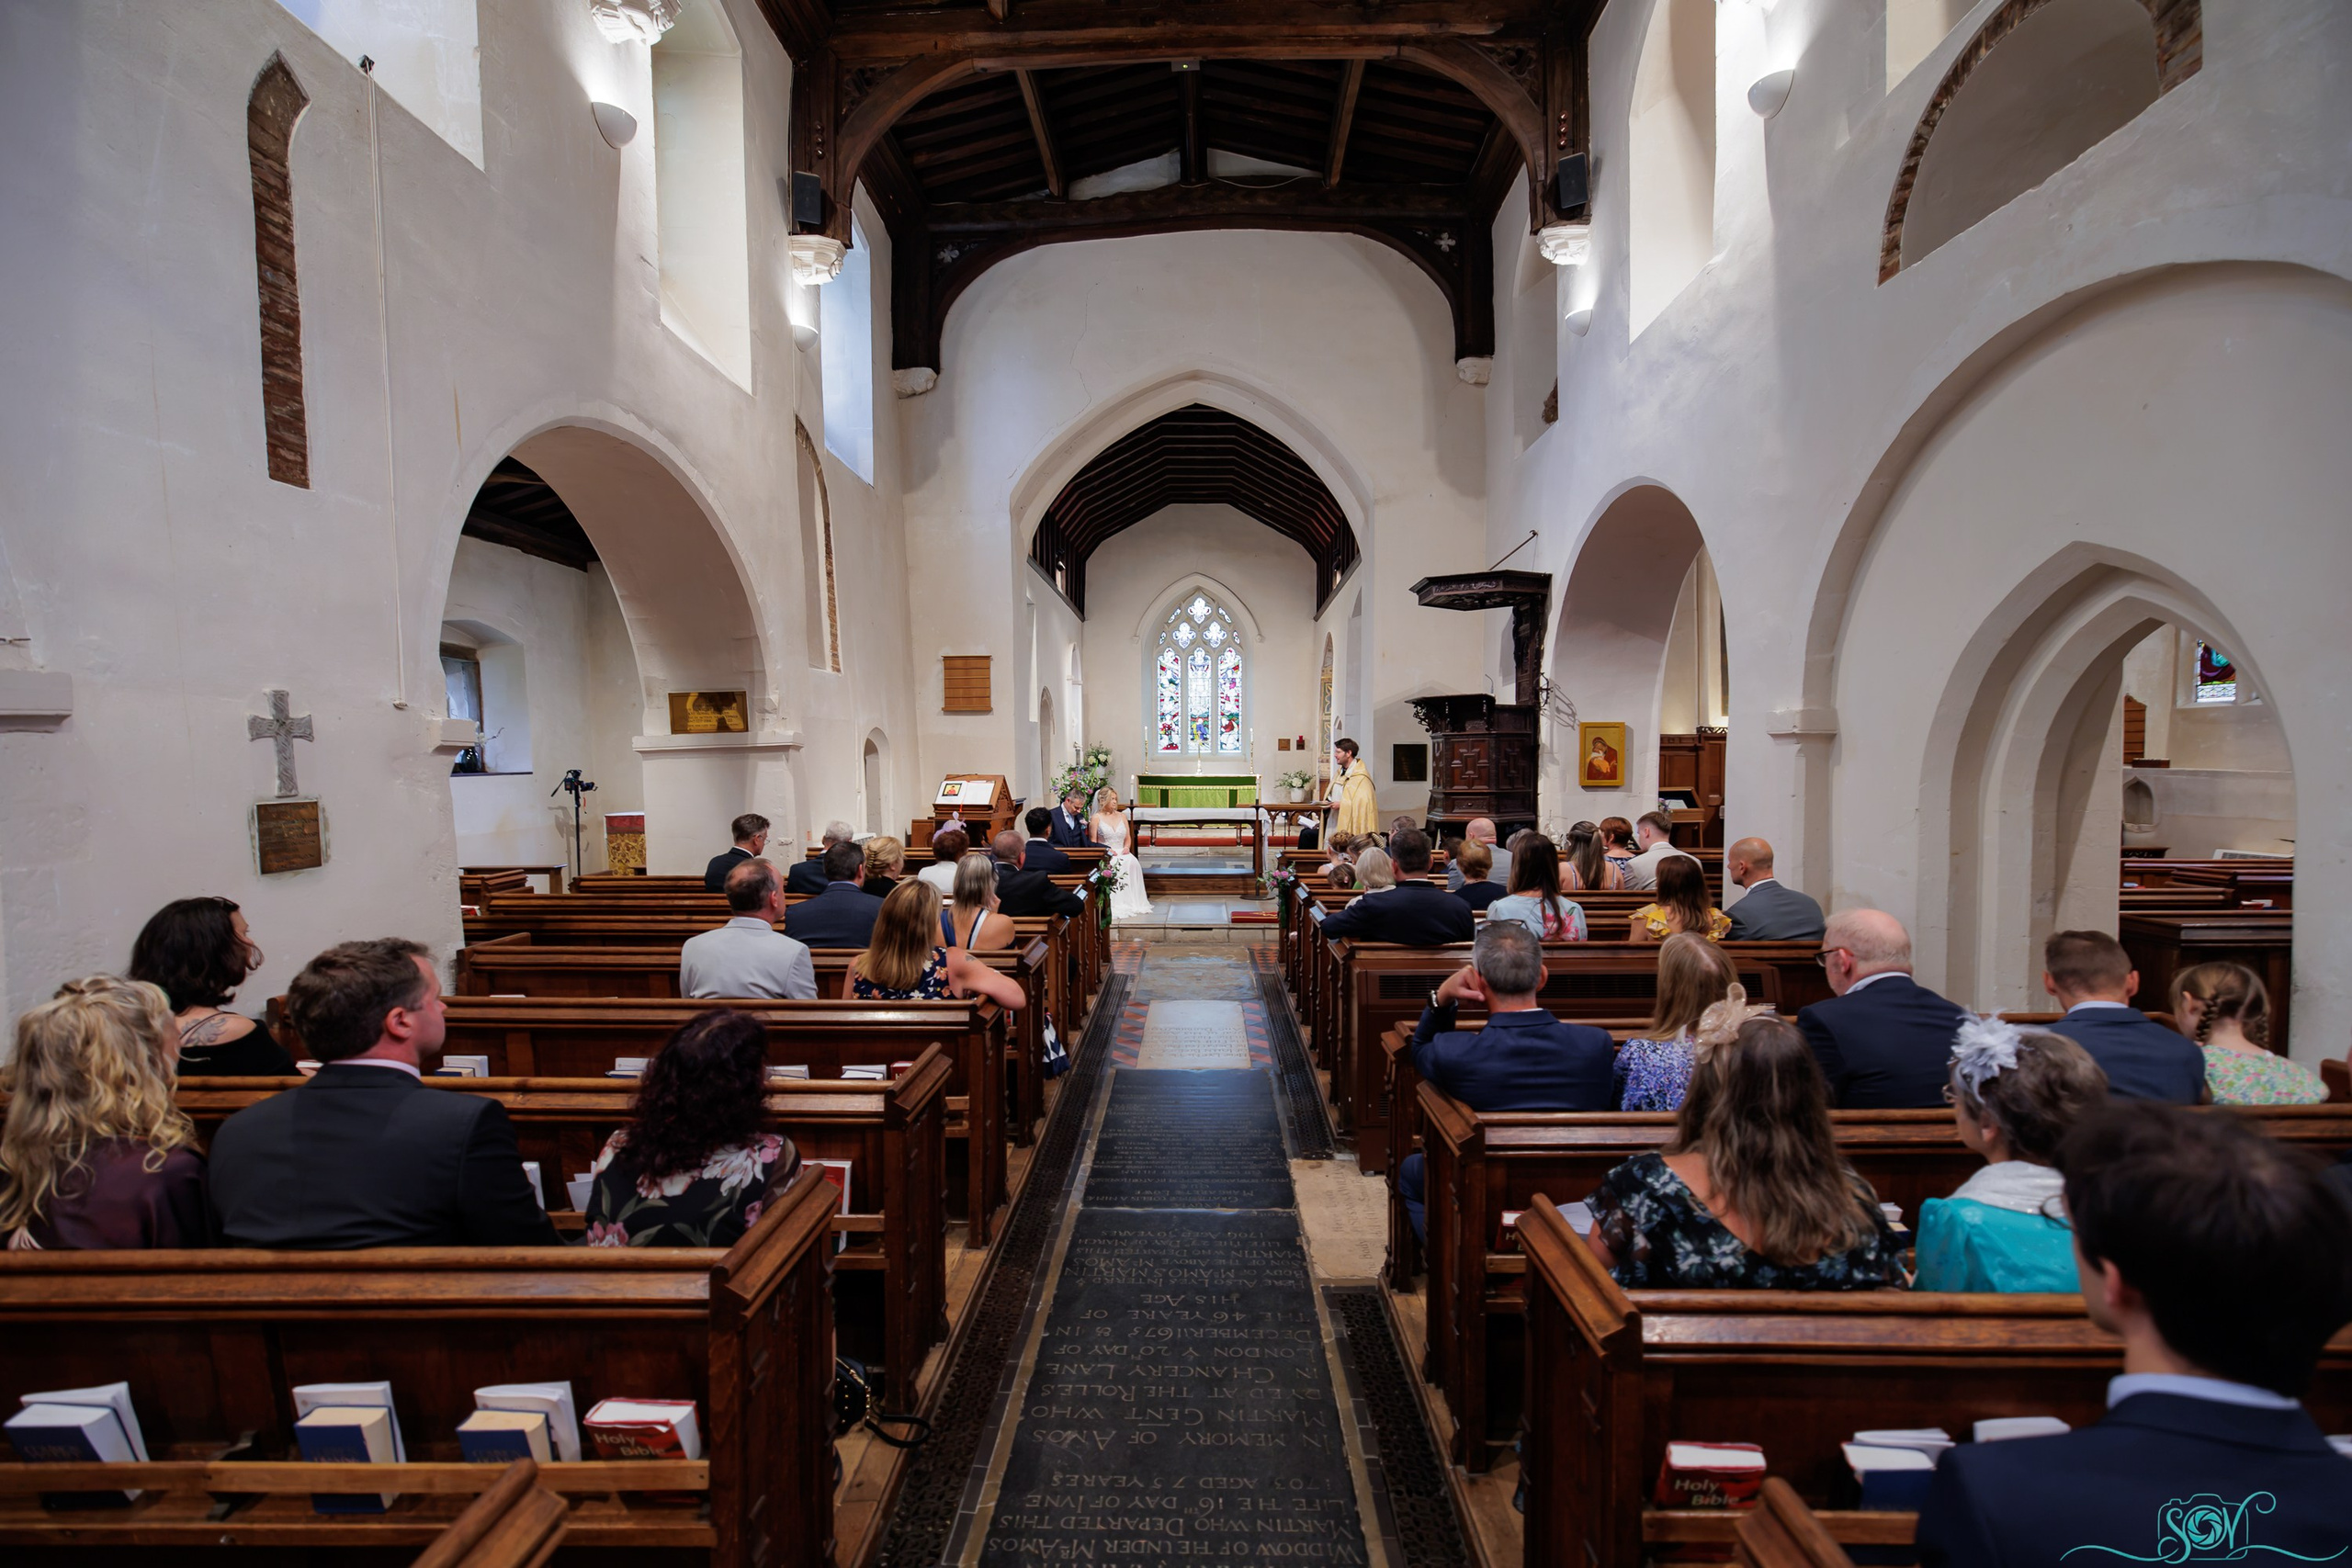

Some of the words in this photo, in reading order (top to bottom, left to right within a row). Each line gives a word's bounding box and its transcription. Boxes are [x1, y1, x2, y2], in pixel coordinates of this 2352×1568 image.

[1183, 1231, 1221, 1240] AGED
[1079, 1238, 1127, 1247] MARCH
[1114, 1247, 1187, 1257] DEPARTED
[1230, 1250, 1301, 1258] MARTIN
[1073, 1257, 1130, 1267] AMOS
[1160, 1257, 1209, 1268] ABOVE
[1271, 1259, 1301, 1268] SON
[1064, 1267, 1148, 1277] MARTIN
[1154, 1268, 1212, 1278] AMOS
[1261, 1269, 1304, 1278] BODY
[1169, 1278, 1209, 1288] LYES
[1215, 1279, 1258, 1288] ALSO
[1262, 1280, 1305, 1289] HERE
[1139, 1293, 1185, 1306] AGE
[1195, 1295, 1237, 1304] HIS
[1080, 1309, 1108, 1318] OF
[1126, 1309, 1204, 1321] YEARE
[1259, 1312, 1310, 1322] THE
[1055, 1326, 1080, 1336] IN
[1054, 1345, 1081, 1354] OF
[1087, 1345, 1128, 1355] DAY
[1214, 1348, 1316, 1362] LONDON
[1046, 1363, 1115, 1379] LANE
[1127, 1363, 1274, 1382] CHANCERY
[1295, 1367, 1318, 1379] IN
[1040, 1383, 1136, 1402] ROLLES
[1143, 1385, 1193, 1398] THE
[1210, 1387, 1238, 1399] AT
[1249, 1388, 1321, 1400] DYED
[1031, 1405, 1103, 1419] WHO
[1124, 1405, 1204, 1426] GENT
[1217, 1409, 1327, 1427] MARTIN
[594, 1433, 636, 1447] Holy
[1033, 1429, 1116, 1450] AMOS
[1127, 1431, 1157, 1444] OF
[1178, 1432, 1285, 1446] MEMORY
[619, 1445, 666, 1457] Bible
[1302, 1434, 1330, 1455] IN
[1051, 1472, 1143, 1488] YEARES
[1200, 1477, 1259, 1490] AGED
[1674, 1479, 1721, 1494] Holy
[1090, 1495, 1120, 1508] OF
[1127, 1495, 1177, 1508] DAY
[1238, 1497, 1282, 1510] THE
[1690, 1494, 1740, 1506] Bible
[1292, 1498, 1346, 1516] LIFE
[1000, 1515, 1053, 1529] THIS
[1060, 1516, 1184, 1537] DEPARTED
[1194, 1518, 1249, 1532] WHO
[1256, 1518, 1354, 1540] MARTIN
[989, 1538, 1060, 1559] AMOS
[1103, 1540, 1172, 1554] UNDER
[1178, 1540, 1214, 1555] THE
[1219, 1540, 1249, 1555] OF
[1256, 1542, 1363, 1564] WIDDOW
